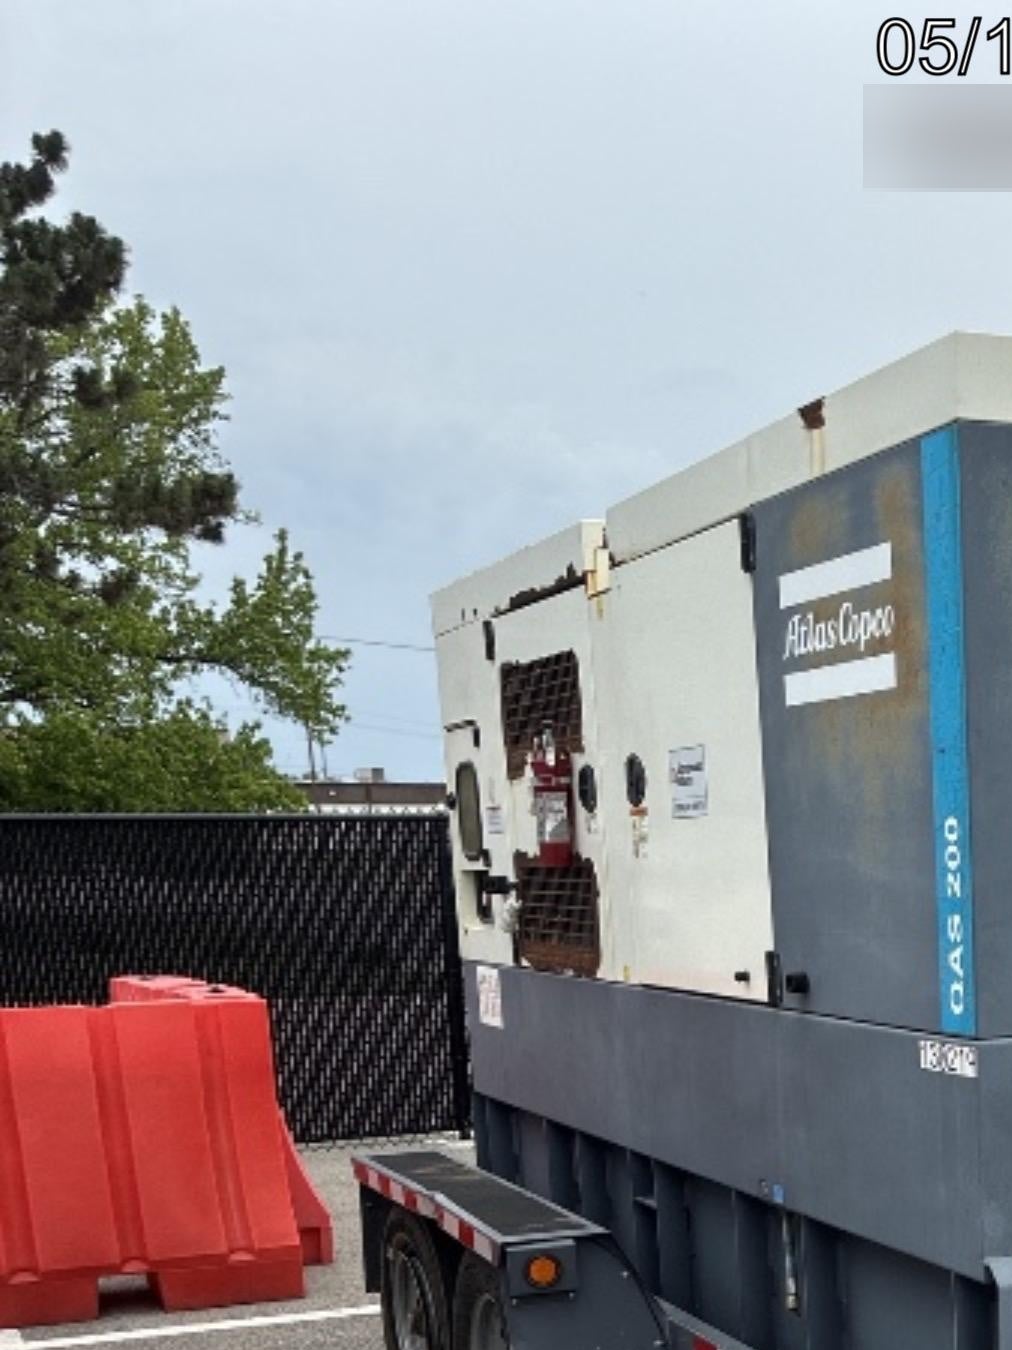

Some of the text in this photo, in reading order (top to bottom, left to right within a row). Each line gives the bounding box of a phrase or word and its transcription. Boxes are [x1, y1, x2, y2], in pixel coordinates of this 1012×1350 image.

[783, 602, 895, 661] Atlas Copco
[944, 815, 965, 1015] QAS 200
